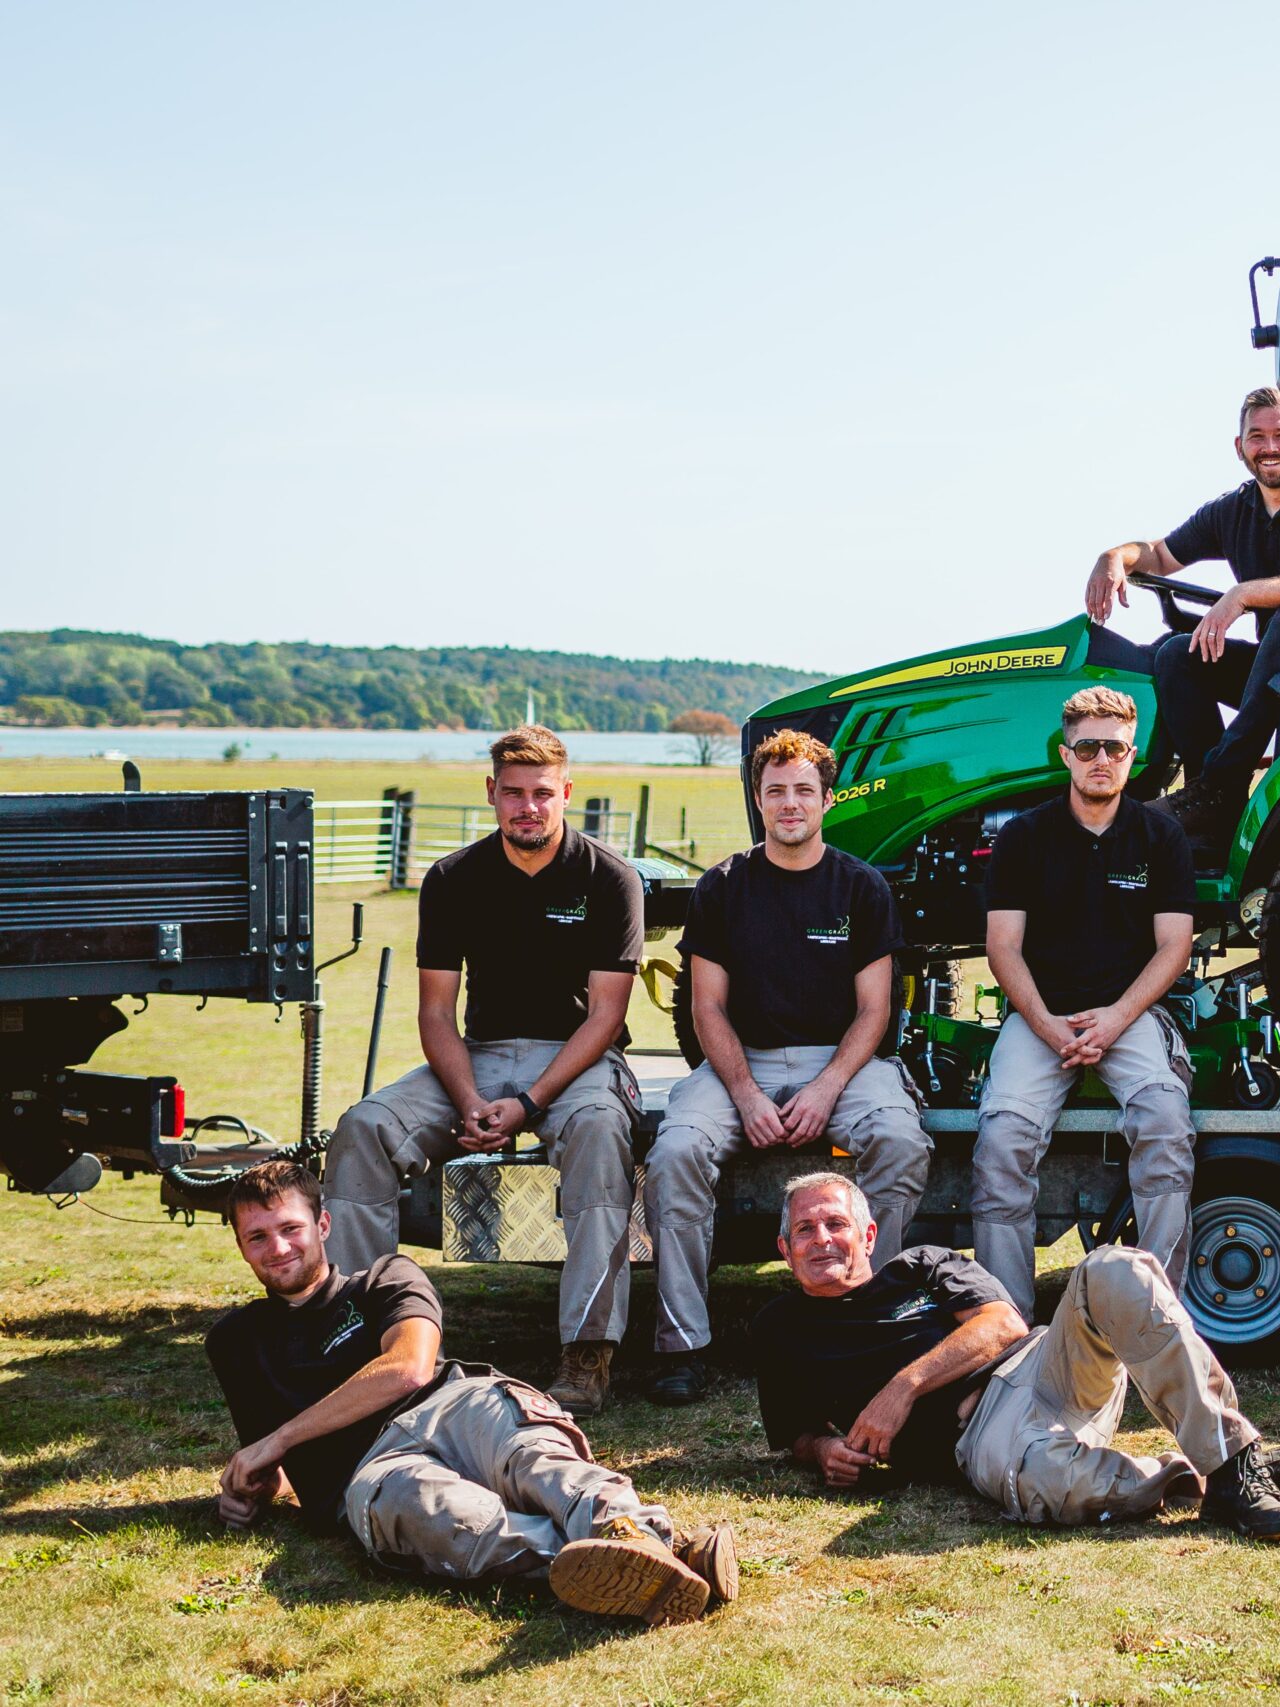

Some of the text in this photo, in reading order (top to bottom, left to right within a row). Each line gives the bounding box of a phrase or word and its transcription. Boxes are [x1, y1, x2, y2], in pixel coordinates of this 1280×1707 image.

[944, 654, 1055, 675] JOHN DEERE
[873, 778, 886, 792] R
